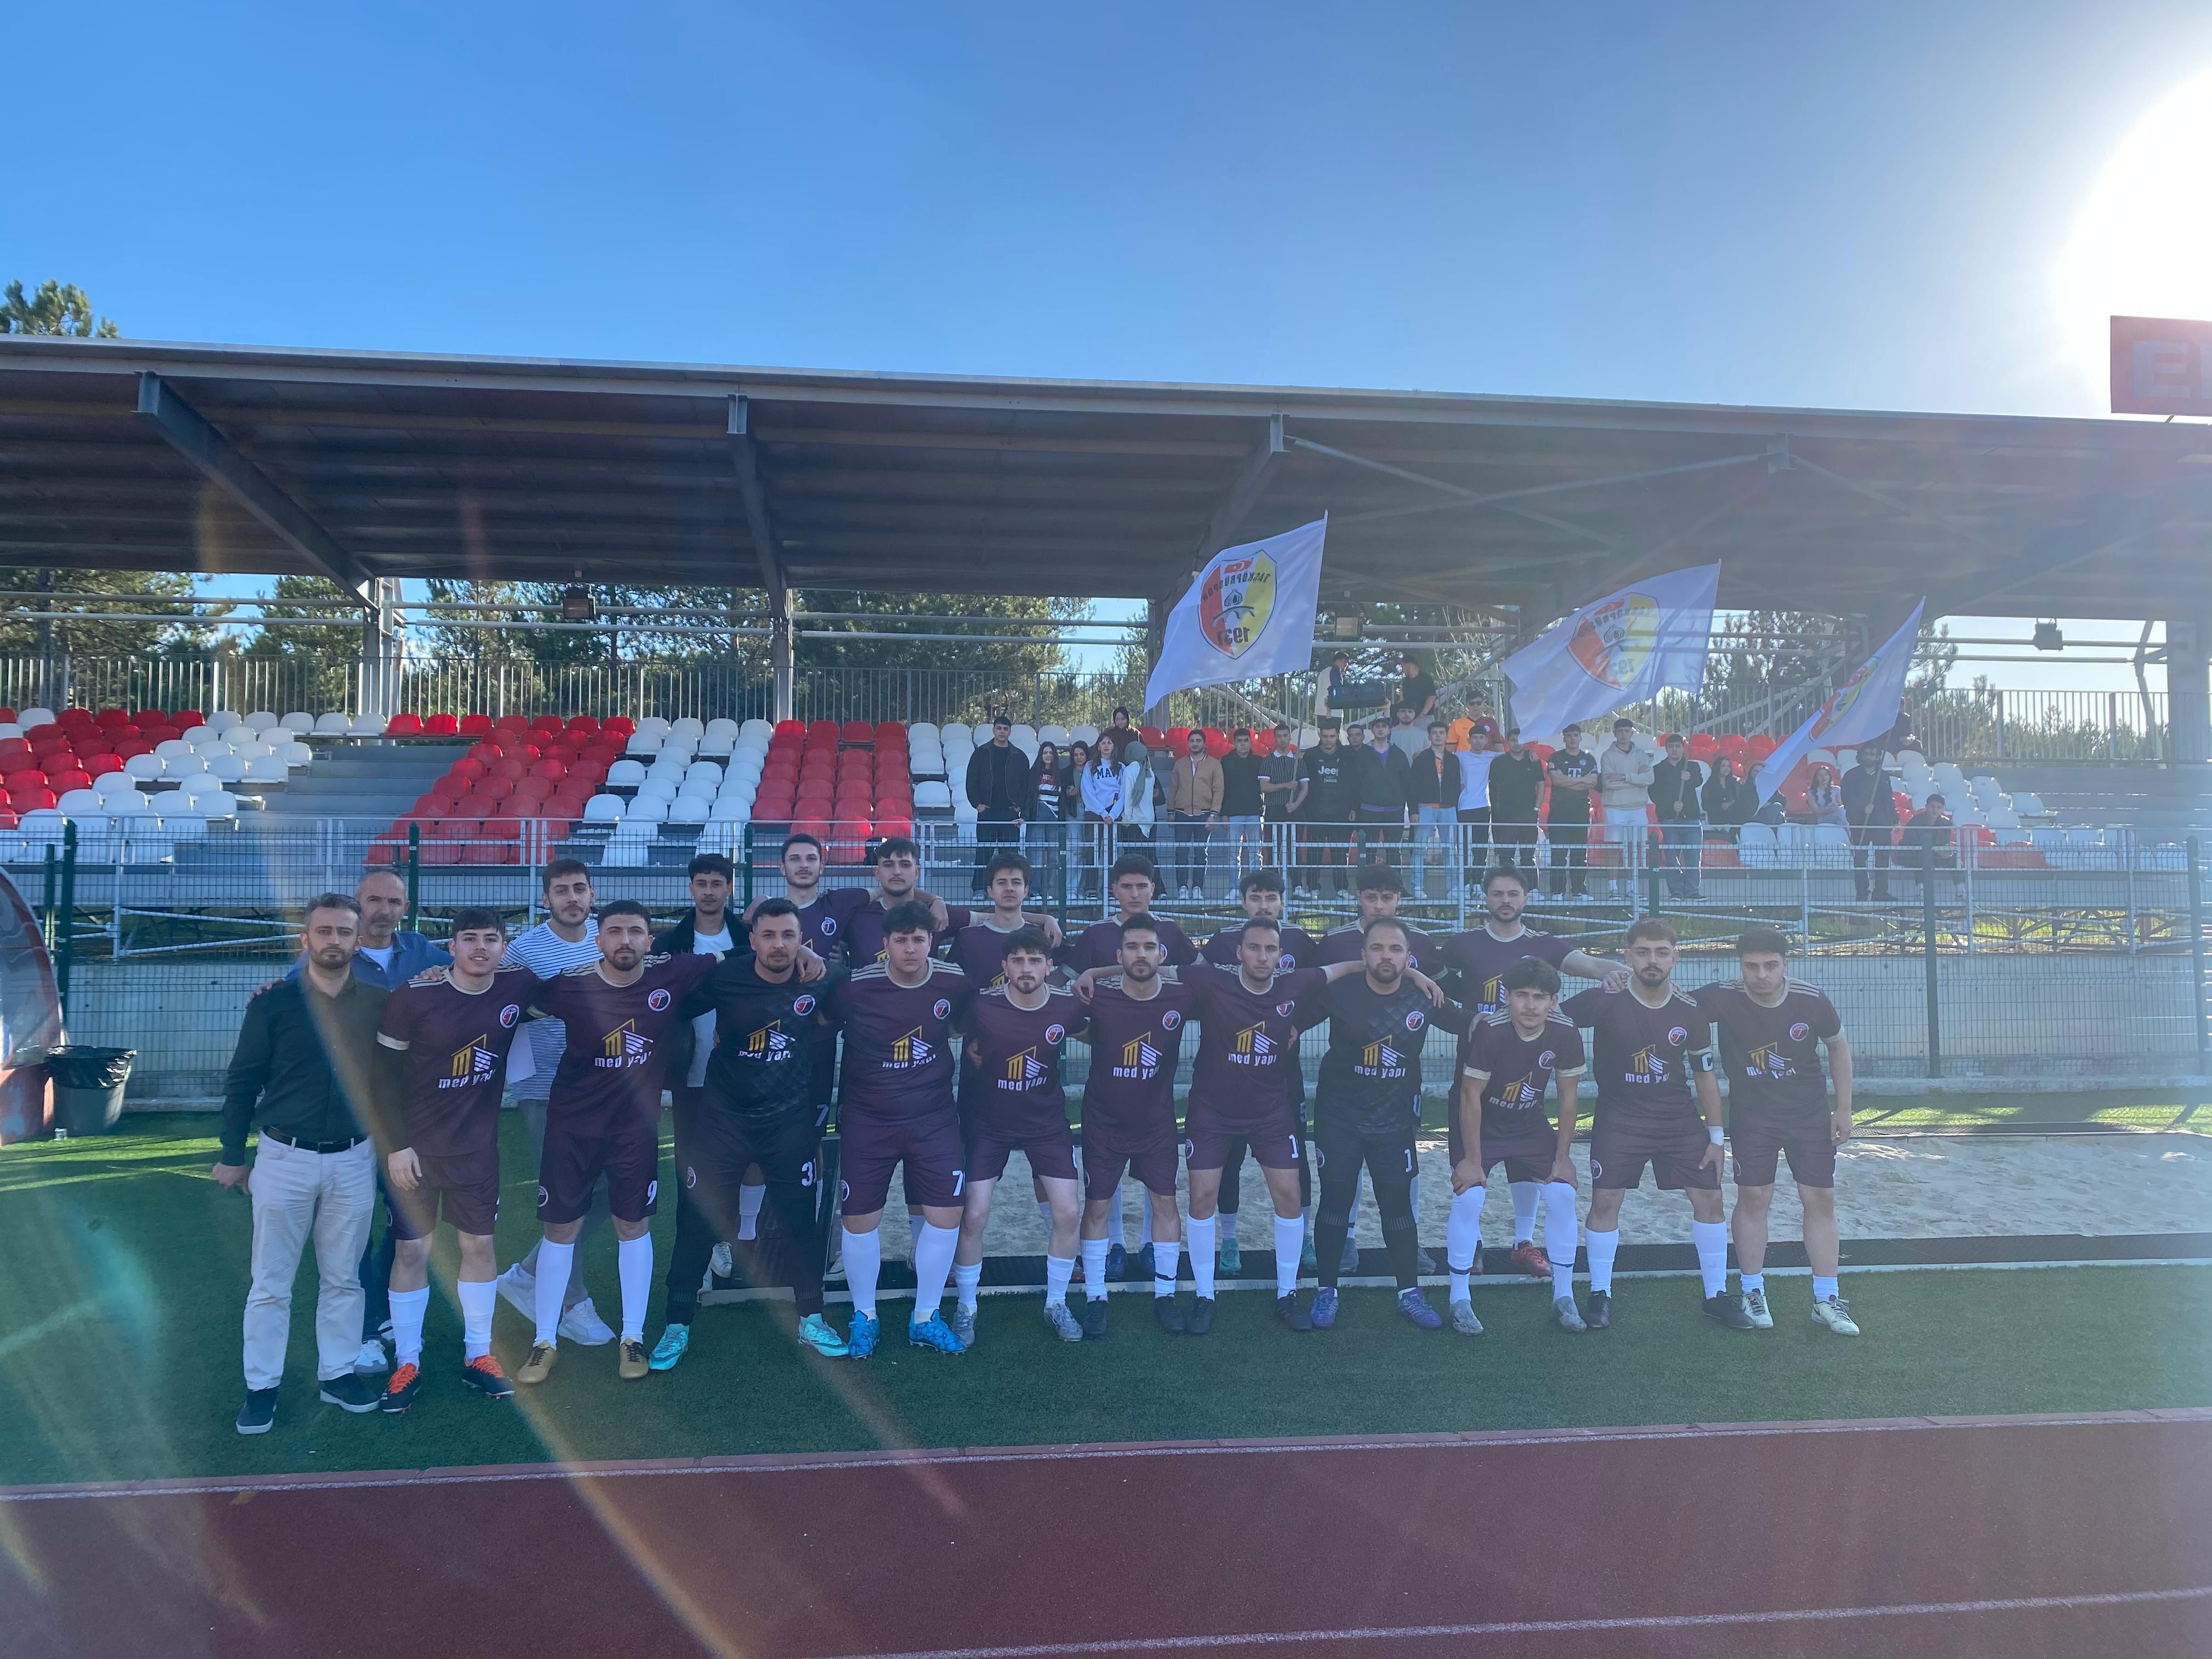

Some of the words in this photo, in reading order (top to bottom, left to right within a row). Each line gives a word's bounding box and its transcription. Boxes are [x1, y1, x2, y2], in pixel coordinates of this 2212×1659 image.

[594, 1056, 622, 1068] med
[1228, 1052, 1250, 1064] med
[1702, 1053, 1713, 1071] C
[1113, 1066, 1137, 1078] med
[1354, 1065, 1378, 1076] med
[438, 1075, 469, 1088] med
[1625, 1073, 1650, 1084] med
[997, 1079, 1023, 1091] med
[1488, 1097, 1514, 1109] med
[645, 1180, 657, 1206] 9
